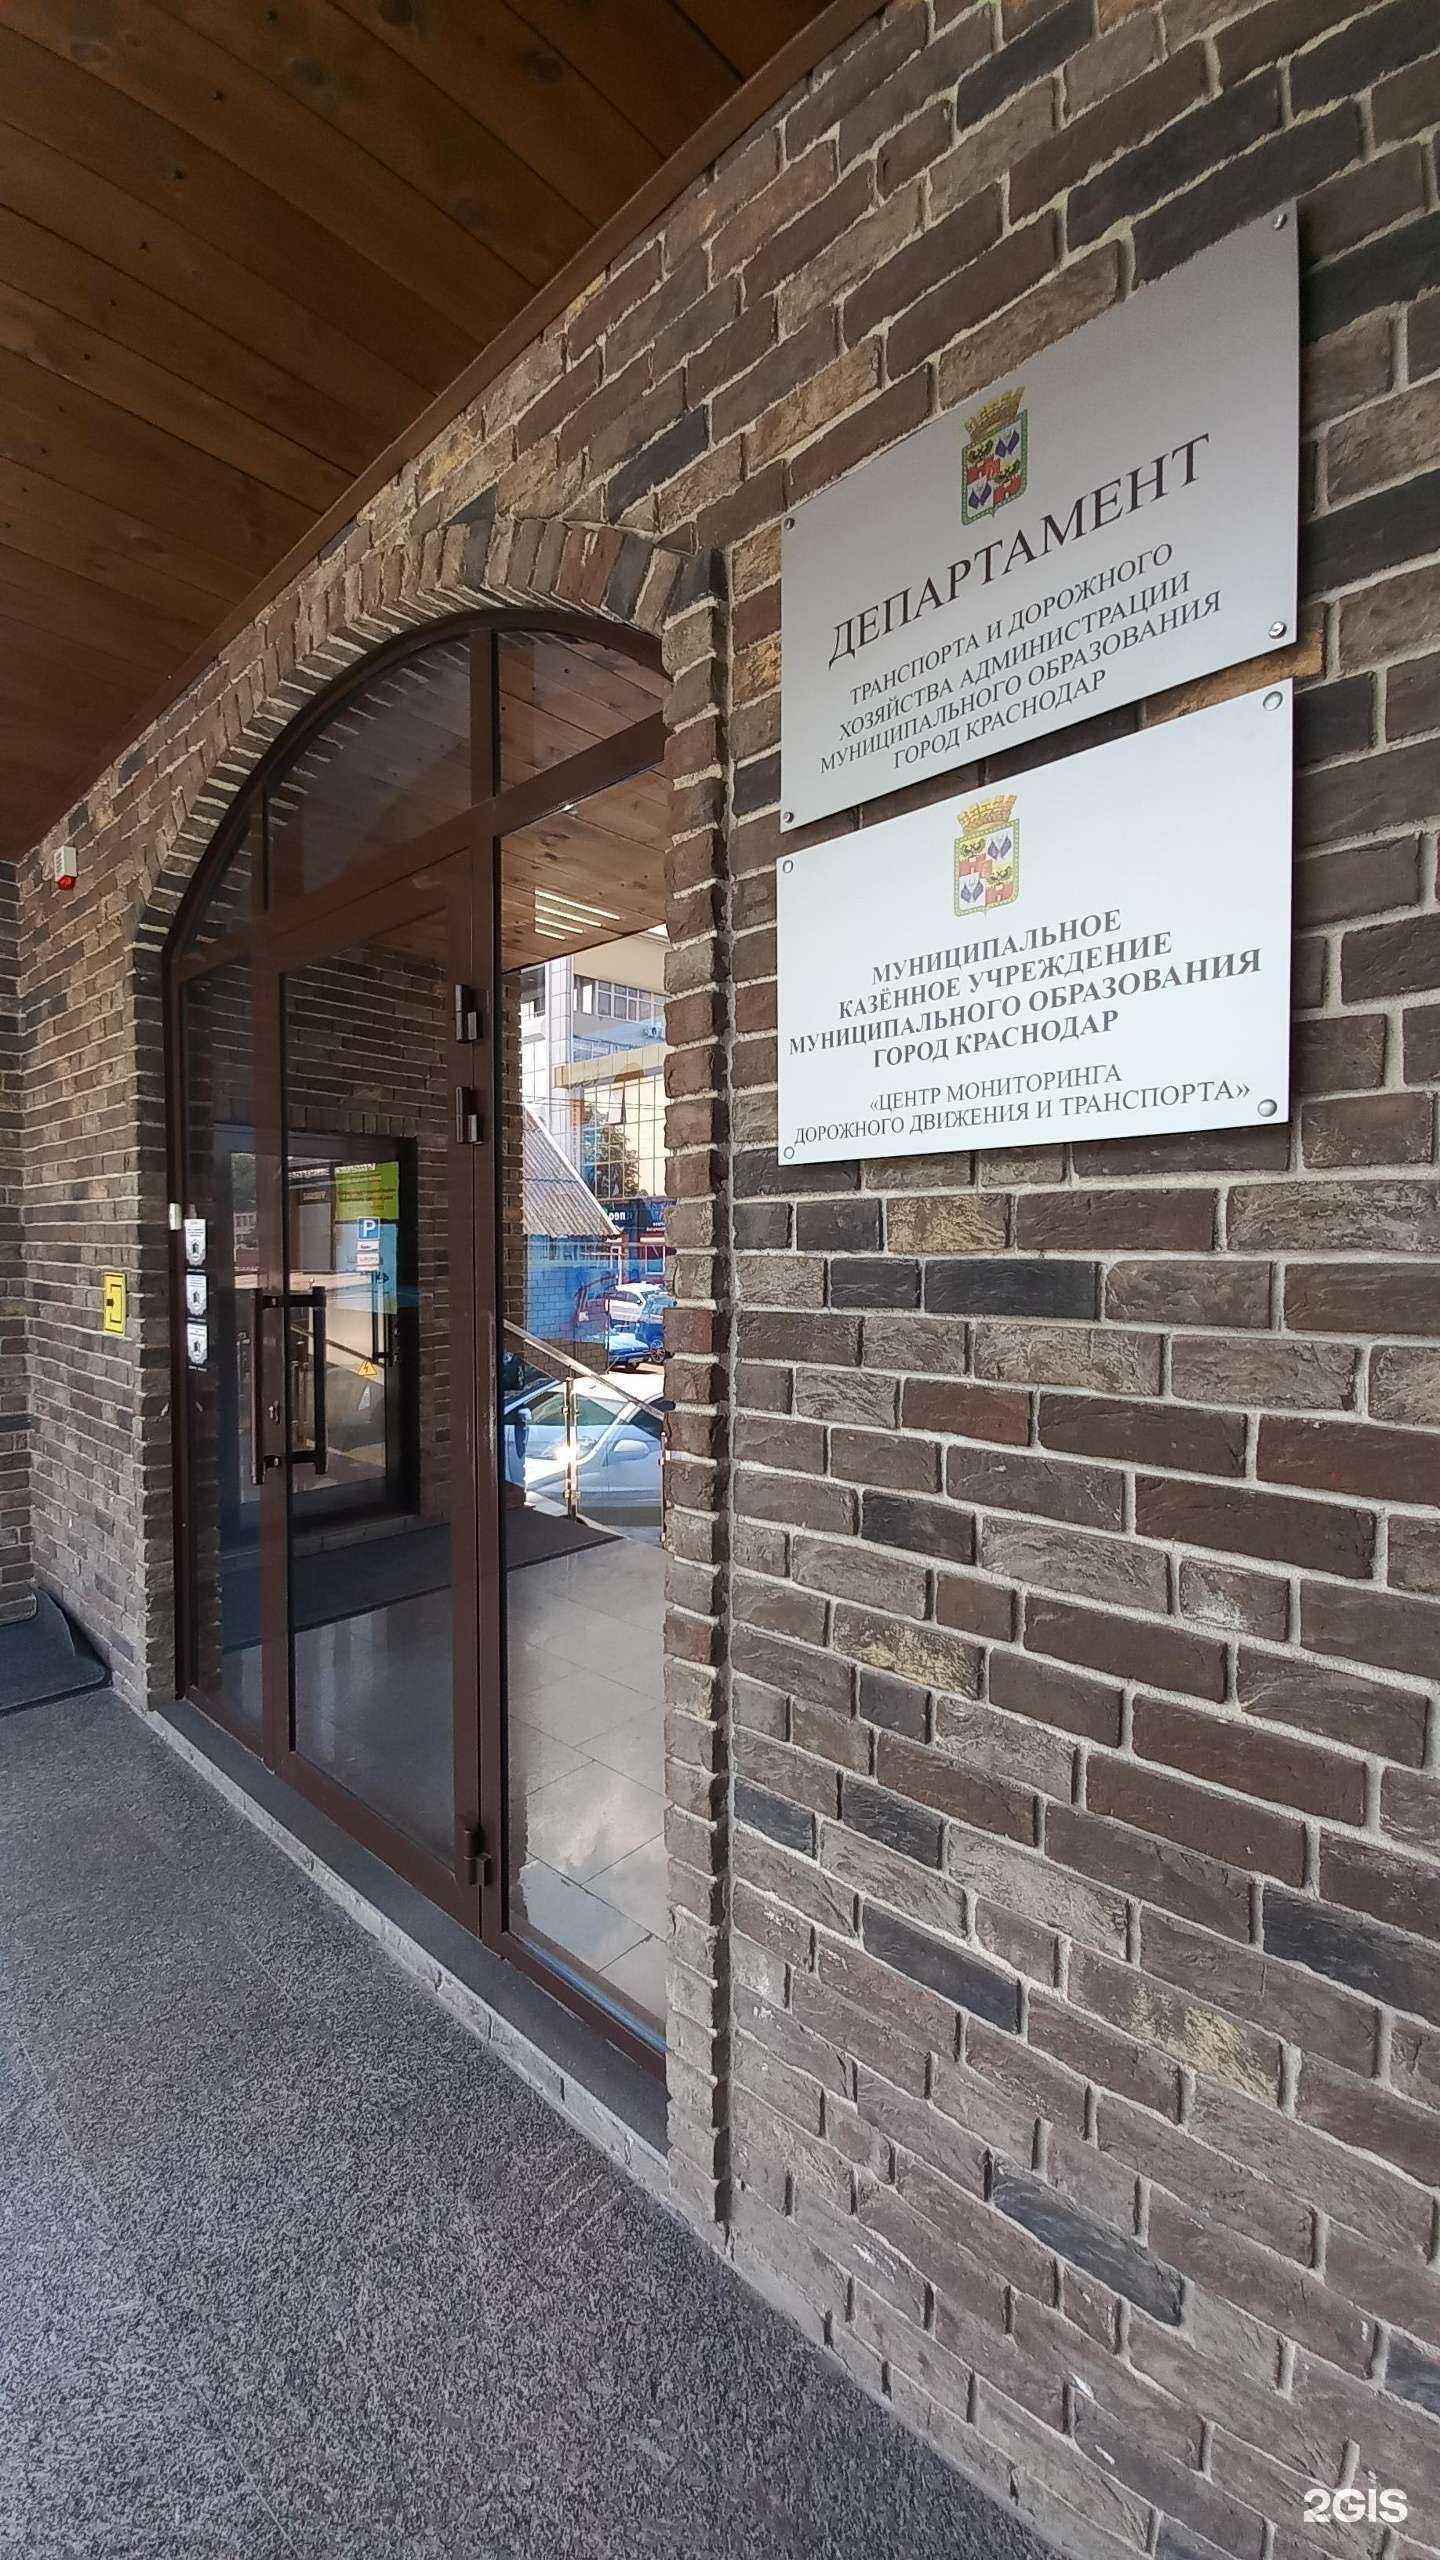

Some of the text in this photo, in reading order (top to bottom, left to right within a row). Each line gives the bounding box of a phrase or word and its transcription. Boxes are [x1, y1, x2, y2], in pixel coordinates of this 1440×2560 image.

[829, 433, 1210, 669] ДЕПАРТАМЕНТ
[840, 571, 1190, 742] ХОЗЯЙСТВА АДМИНИСТРАЦИИ
[849, 543, 1172, 705] ТРАНСПОРТА И ДОРОЖНОГО
[819, 591, 1221, 773] МУНИЦИПАЛЬНОГО ОБРАЗОВАНИЯ
[892, 669, 1106, 768] ГОРОД КРАСНОДАР
[839, 932, 1173, 1019] КАЗЁННОЕ УЧРЕЖДЕНИЕ
[873, 909, 1122, 985] МУНИЦИПАЛЬНОЕ
[789, 948, 1262, 1056] МУНИЦИПАЛЬНОГО ОБРАЗОВАНИЯ
[873, 1009, 1118, 1067] ГОРОД КРАСНОДАР
[794, 1079, 1251, 1145] ДОРОЖНОГО ДВИЖЕНИЯ И ТРАНСПОРТА»
[870, 1063, 1122, 1113] «ЦЕНТР МОНИТОРИНГА
